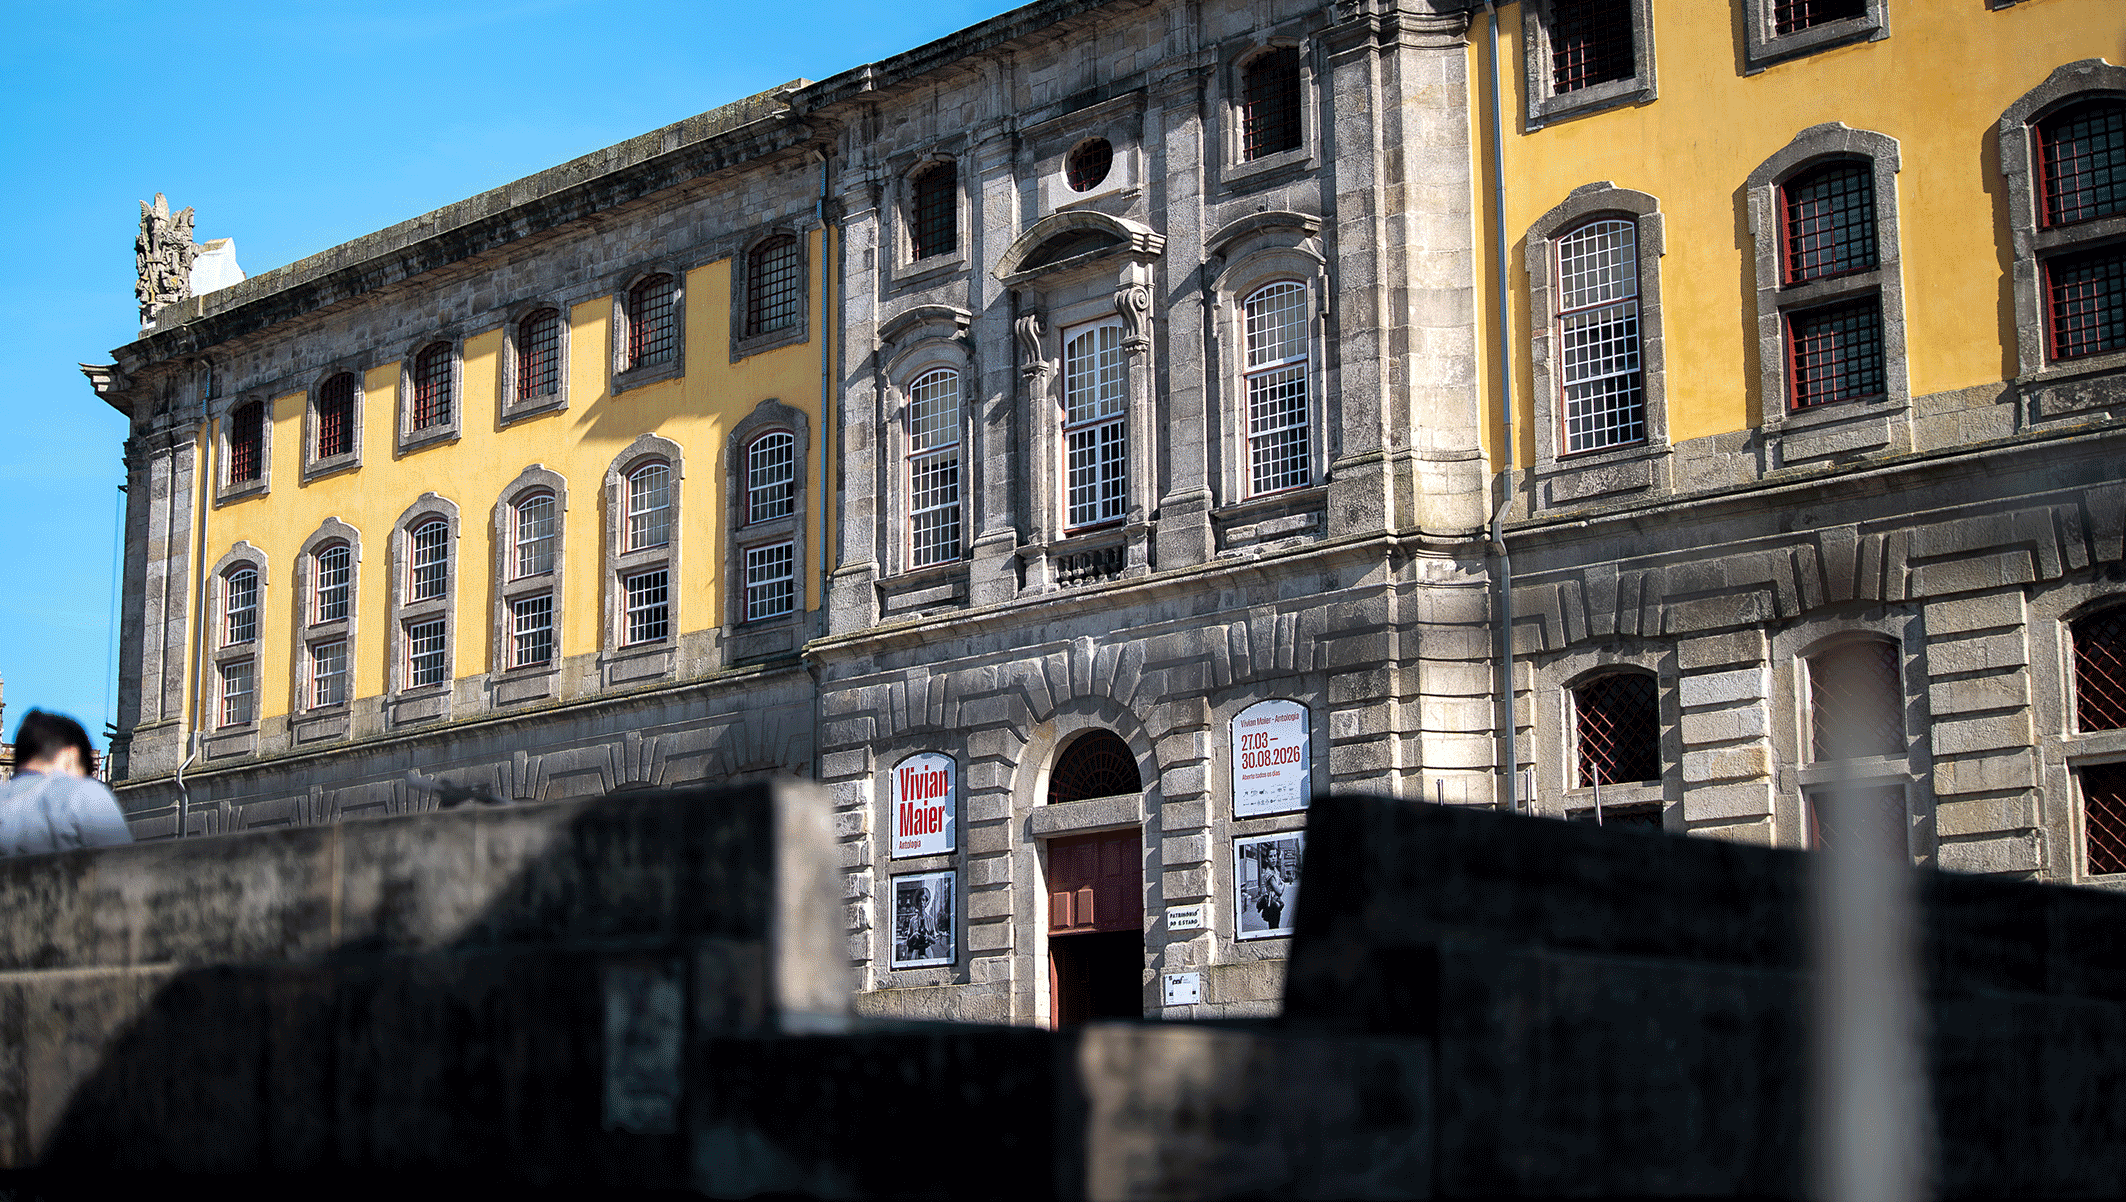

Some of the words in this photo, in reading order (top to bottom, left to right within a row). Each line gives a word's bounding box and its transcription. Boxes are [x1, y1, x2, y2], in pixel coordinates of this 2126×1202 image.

[1241, 719, 1256, 727] Vivian
[1257, 717, 1271, 725] Maier
[1275, 712, 1299, 722] Antologia
[1241, 732, 1268, 751] 27.03
[1242, 745, 1300, 769] 30.08.2026
[900, 764, 948, 802] Vivian
[900, 800, 945, 837] Maier
[899, 839, 921, 849] Antologia
